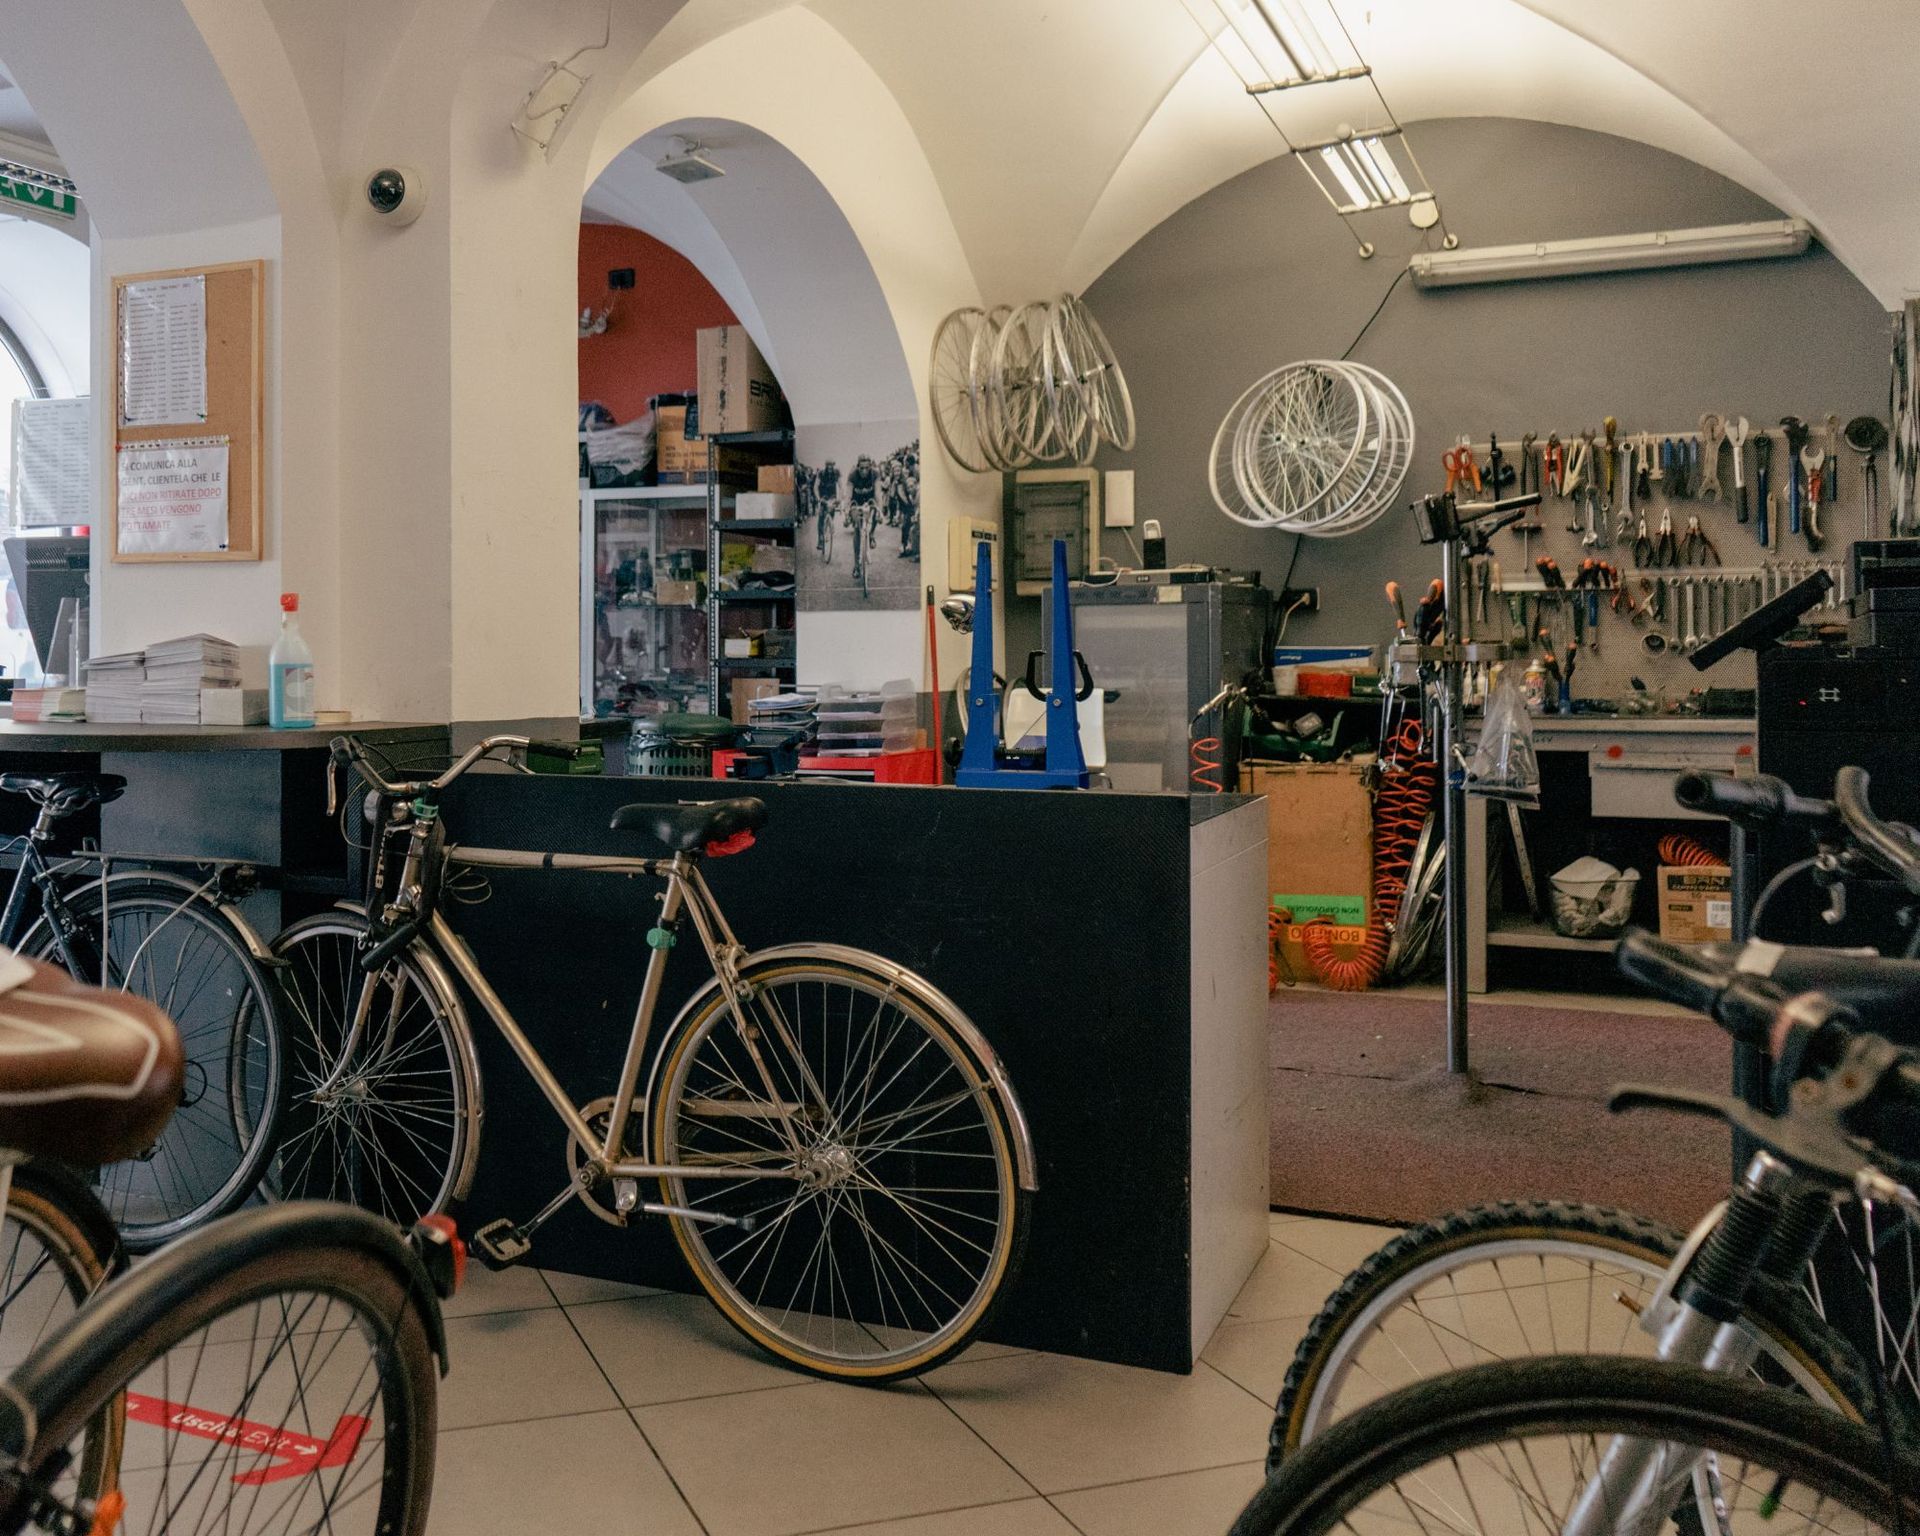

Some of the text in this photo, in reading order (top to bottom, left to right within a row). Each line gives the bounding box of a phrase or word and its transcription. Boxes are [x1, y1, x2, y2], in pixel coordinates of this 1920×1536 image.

[130, 460, 175, 471] COMUNICA
[177, 458, 198, 469] ALLA
[191, 472, 208, 483] CHE
[211, 472, 221, 482] LE
[139, 491, 158, 500] NON
[160, 488, 197, 499] RITIRATE
[198, 487, 222, 498] DOPO
[160, 503, 202, 514] VENGONO
